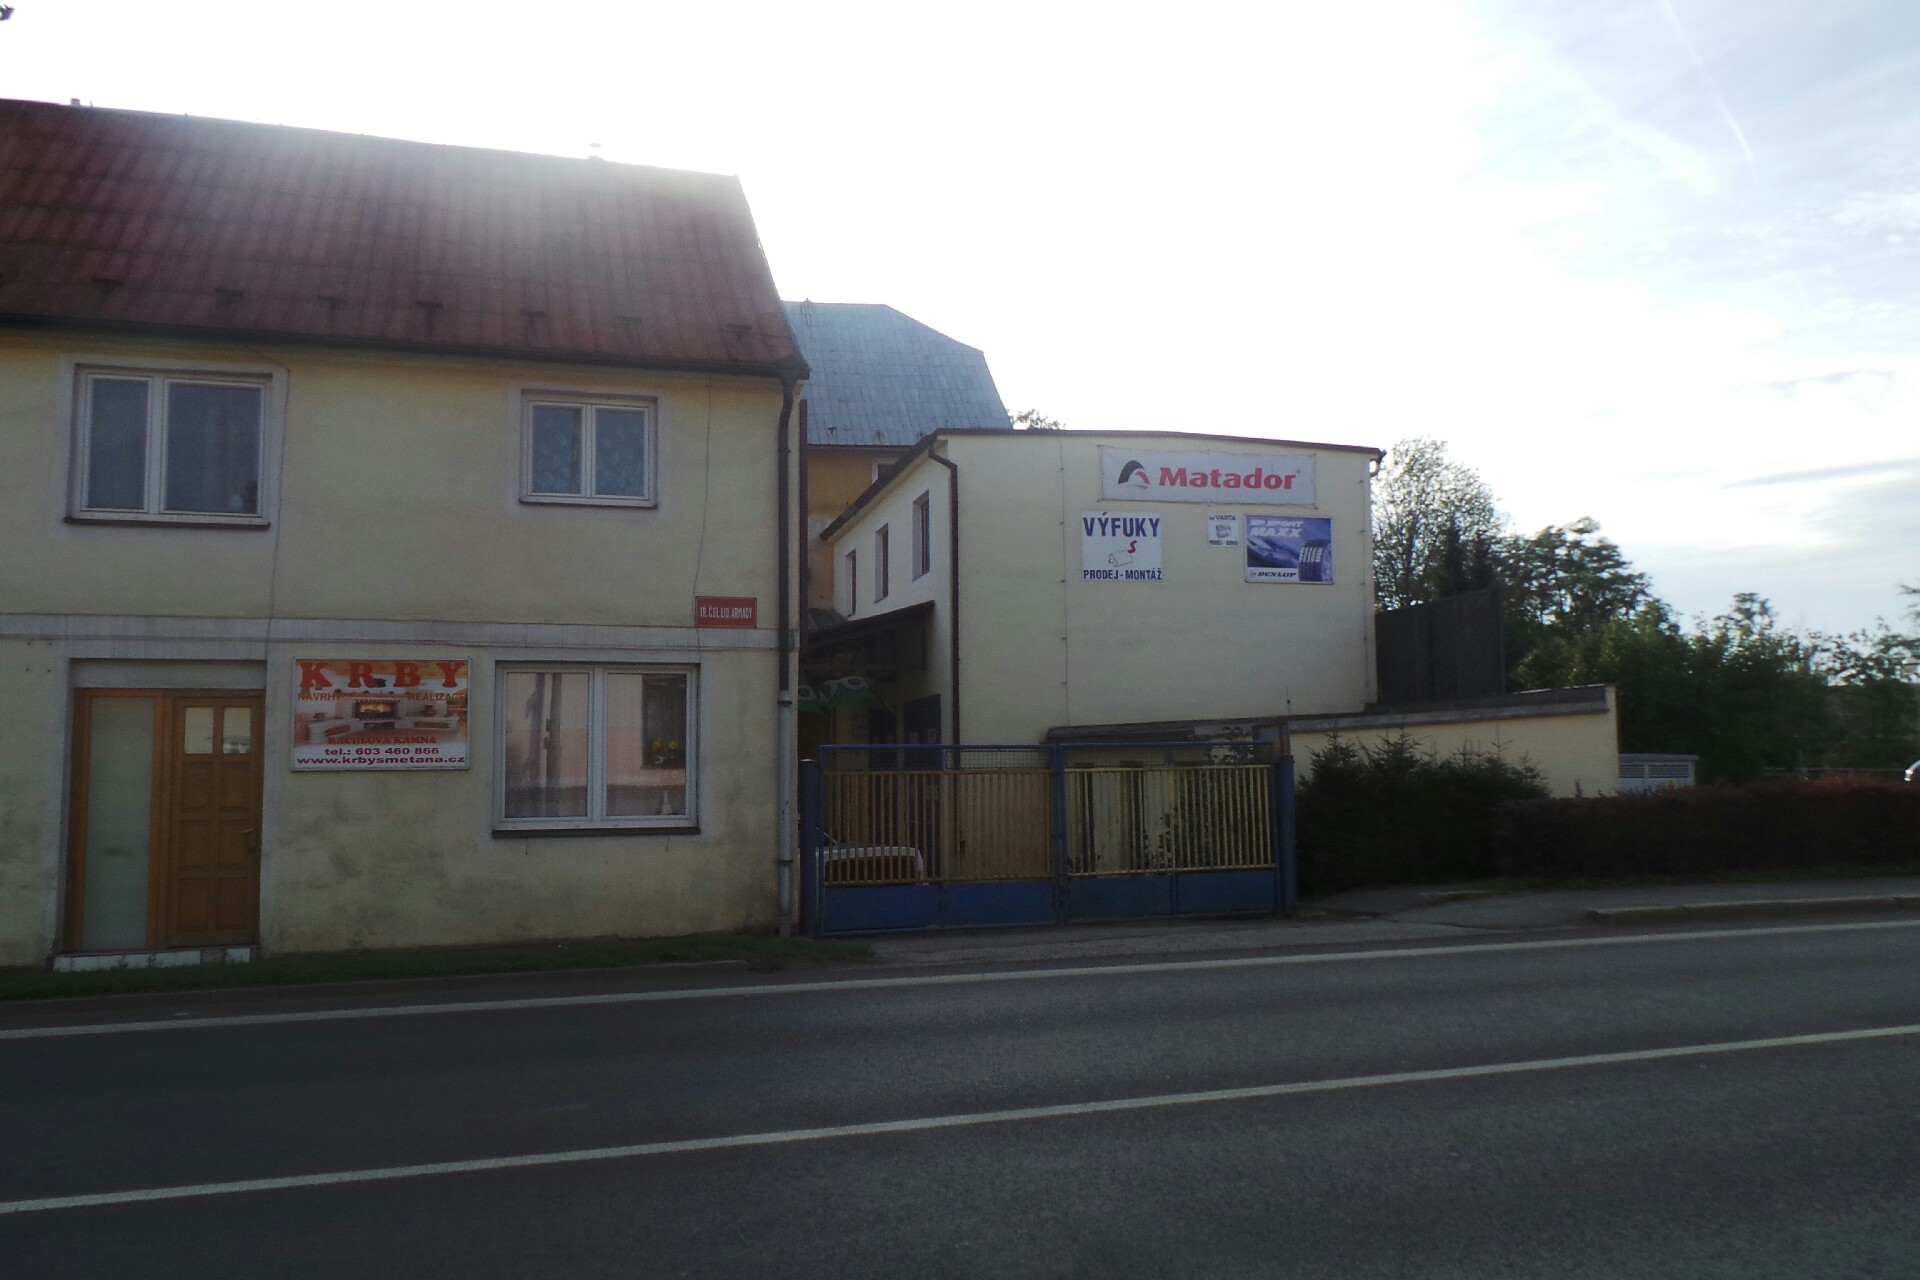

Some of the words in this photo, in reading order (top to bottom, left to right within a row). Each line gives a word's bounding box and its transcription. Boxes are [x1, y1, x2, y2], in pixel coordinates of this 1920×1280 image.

[1159, 467, 1296, 490] Matador
[1083, 512, 1160, 538] VÝFUKY
[1083, 569, 1119, 580] PRODEJ
[1125, 567, 1162, 580] MONTÁŽ
[296, 662, 466, 689] KRBY
[325, 748, 351, 756] tel.:
[355, 748, 381, 756] 603
[385, 747, 410, 755] 460
[414, 747, 439, 755] 866
[297, 756, 465, 766] www.krbysmetana.cz
